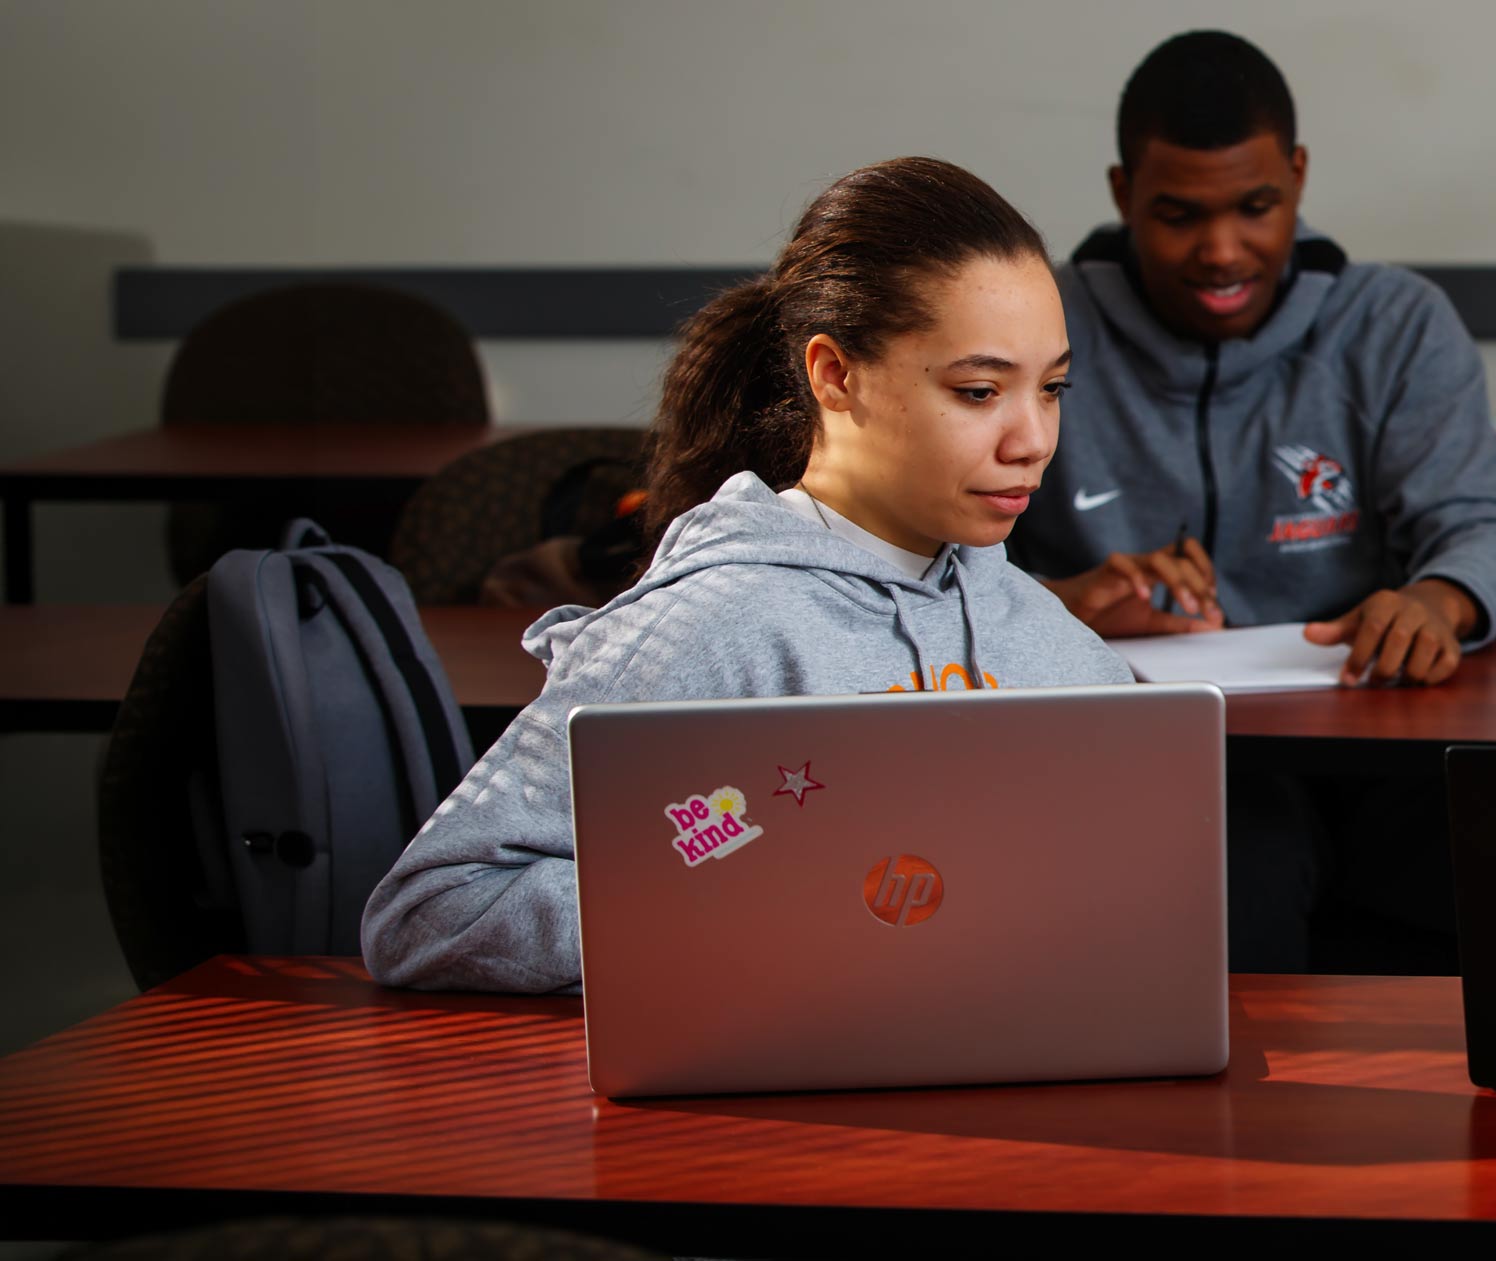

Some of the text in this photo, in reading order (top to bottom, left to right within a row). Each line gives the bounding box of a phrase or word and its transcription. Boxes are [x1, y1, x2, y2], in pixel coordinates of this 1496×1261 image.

[669, 798, 709, 831] be
[676, 812, 744, 863] kind
[871, 855, 938, 927] hp
